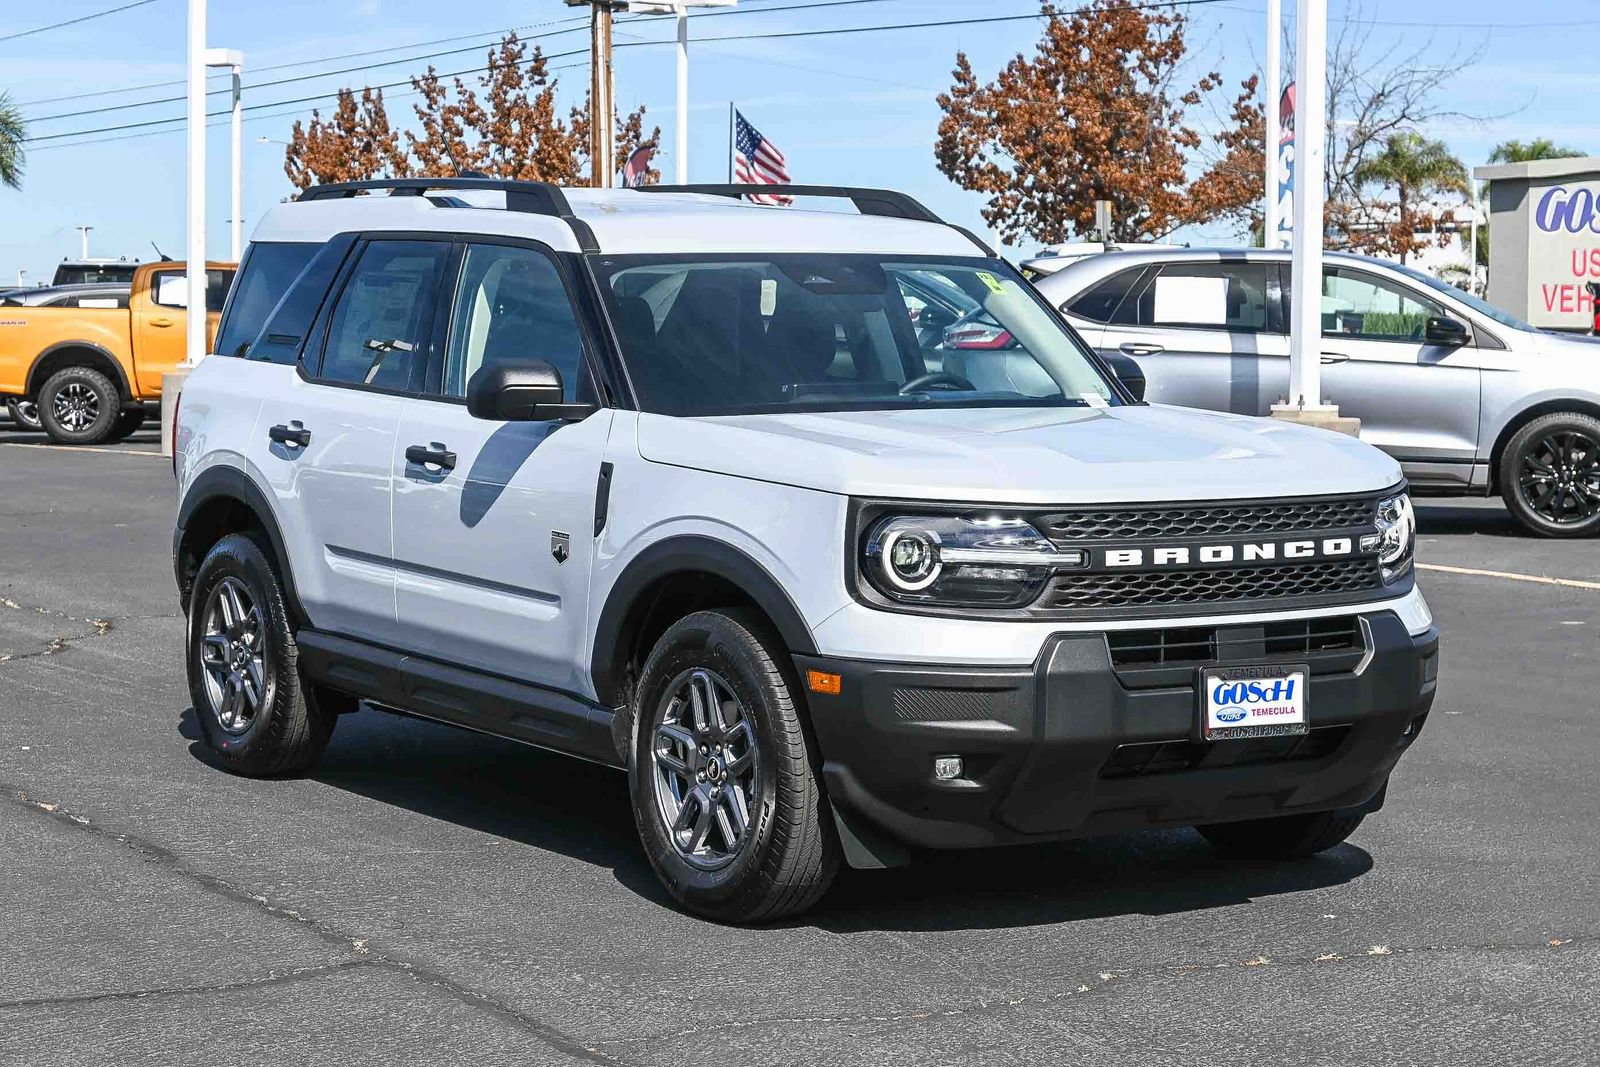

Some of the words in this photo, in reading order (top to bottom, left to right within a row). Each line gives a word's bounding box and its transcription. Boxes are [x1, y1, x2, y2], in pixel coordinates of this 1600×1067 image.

[1105, 538, 1352, 566] BRONCO
[1229, 666, 1283, 678] TEMECULA
[1218, 709, 1244, 722] Ford
[1251, 706, 1296, 717] TEMECULA
